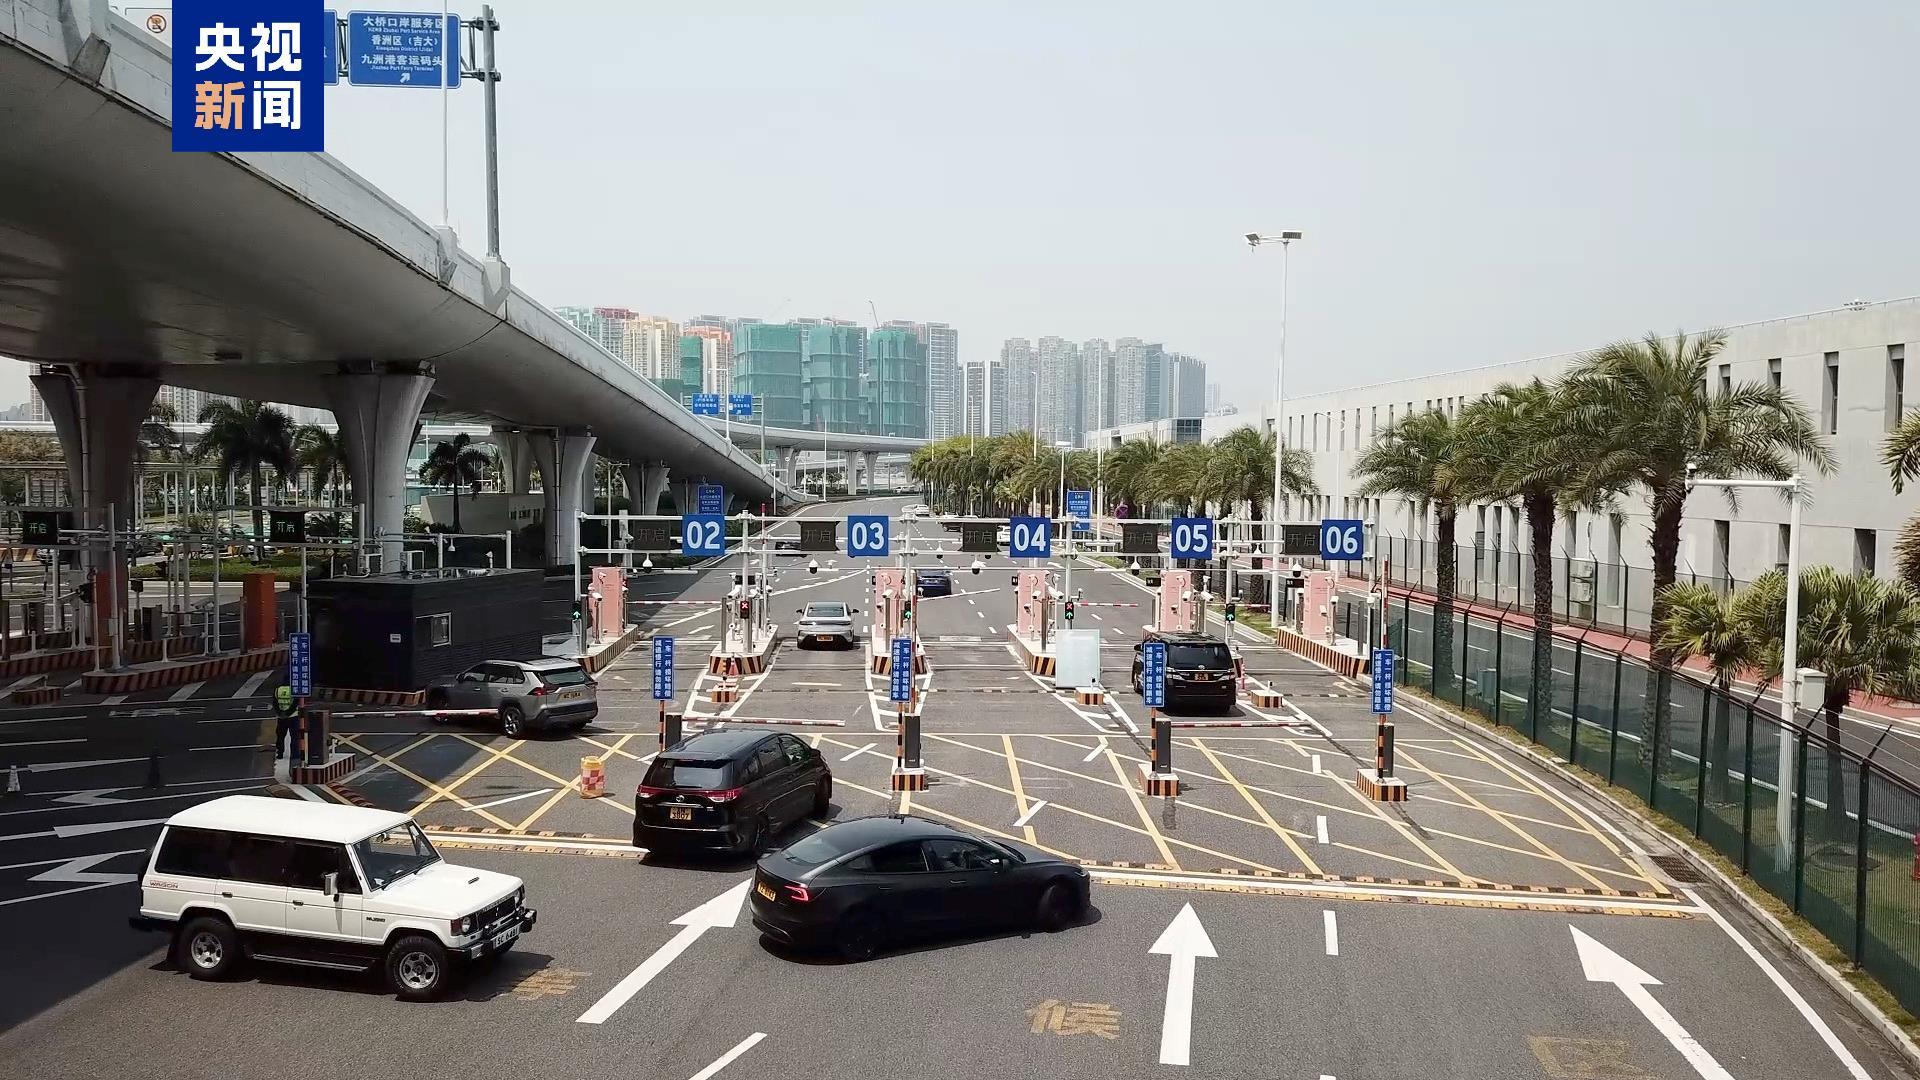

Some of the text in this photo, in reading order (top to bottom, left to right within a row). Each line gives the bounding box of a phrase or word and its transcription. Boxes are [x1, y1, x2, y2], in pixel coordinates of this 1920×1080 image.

[686, 520, 720, 549] 02
[851, 522, 885, 550] 03
[965, 530, 993, 544] 开启
[1014, 523, 1047, 552] 04
[1175, 524, 1208, 552] 05
[1287, 533, 1316, 546] 开启
[1326, 526, 1358, 554] 06
